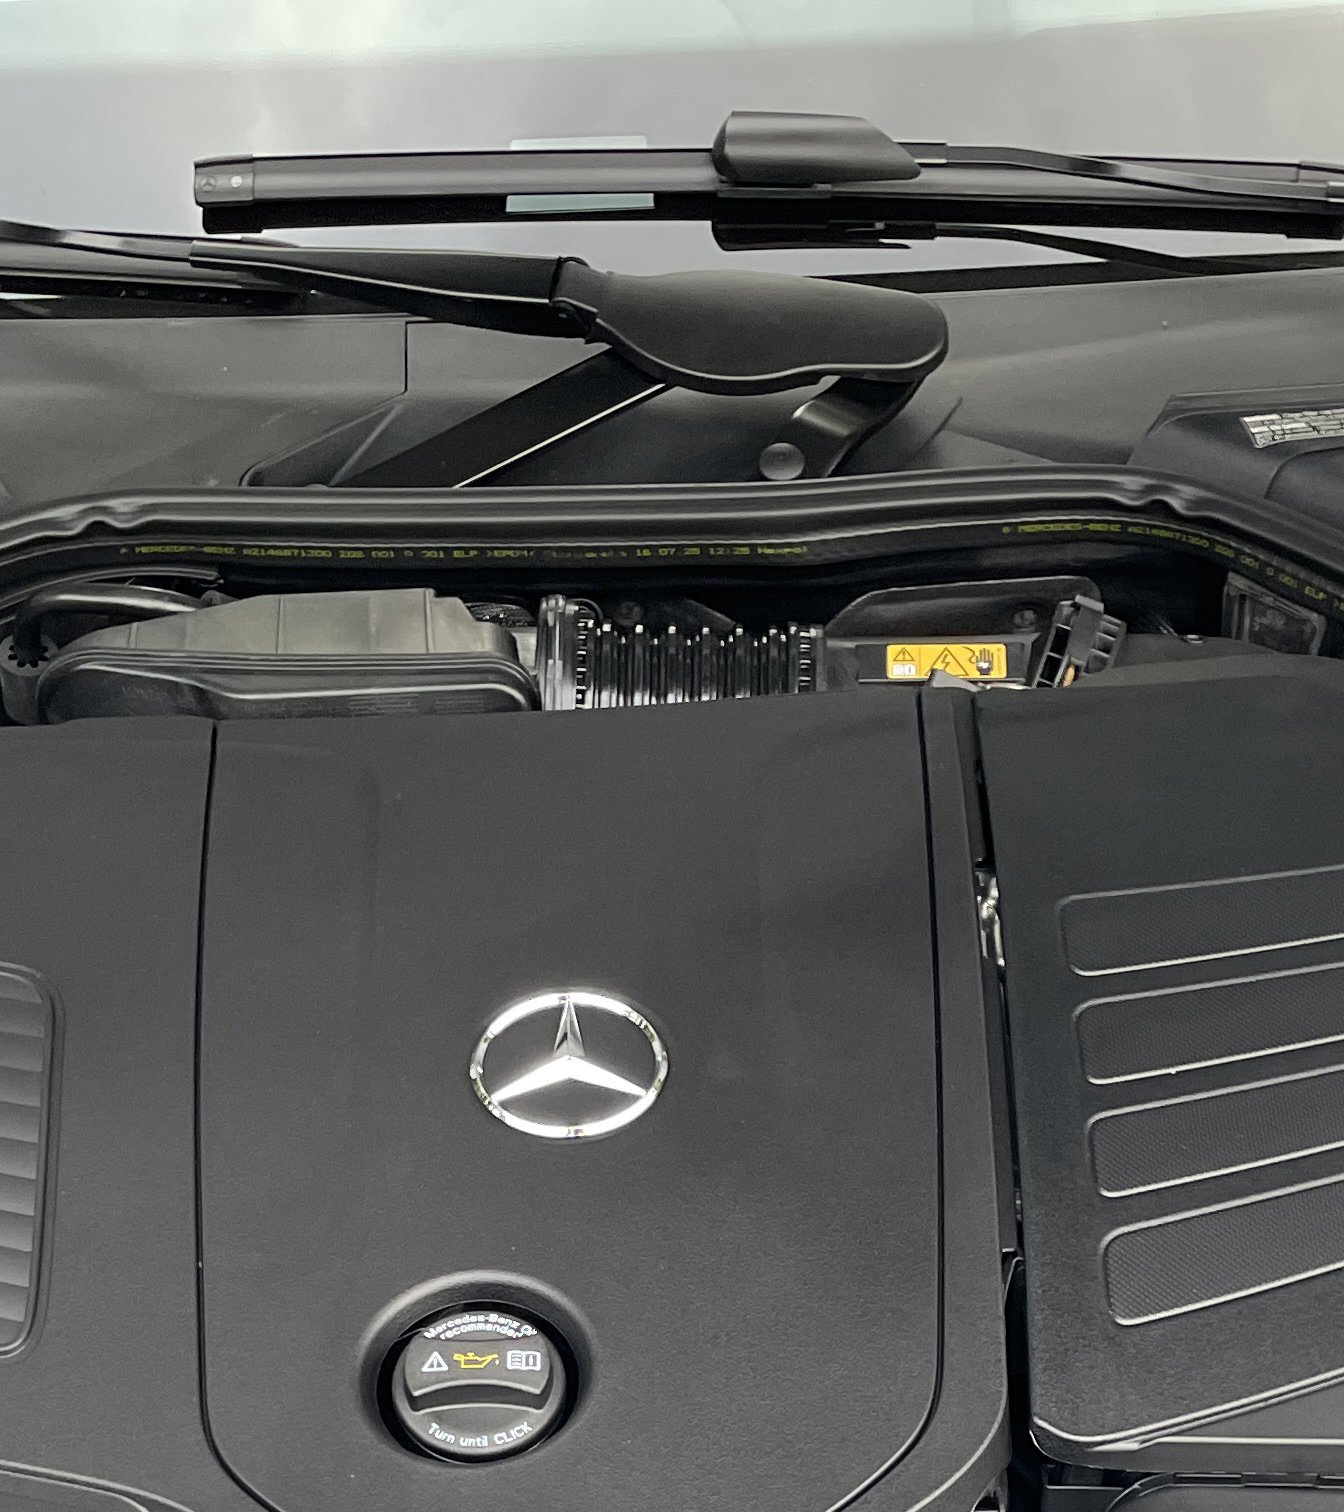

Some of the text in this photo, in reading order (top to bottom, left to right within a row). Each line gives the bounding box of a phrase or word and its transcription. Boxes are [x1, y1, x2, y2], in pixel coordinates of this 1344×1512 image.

[423, 1313, 521, 1339] Mercedes-Benz
[428, 1421, 533, 1447] Turn until CLICK
